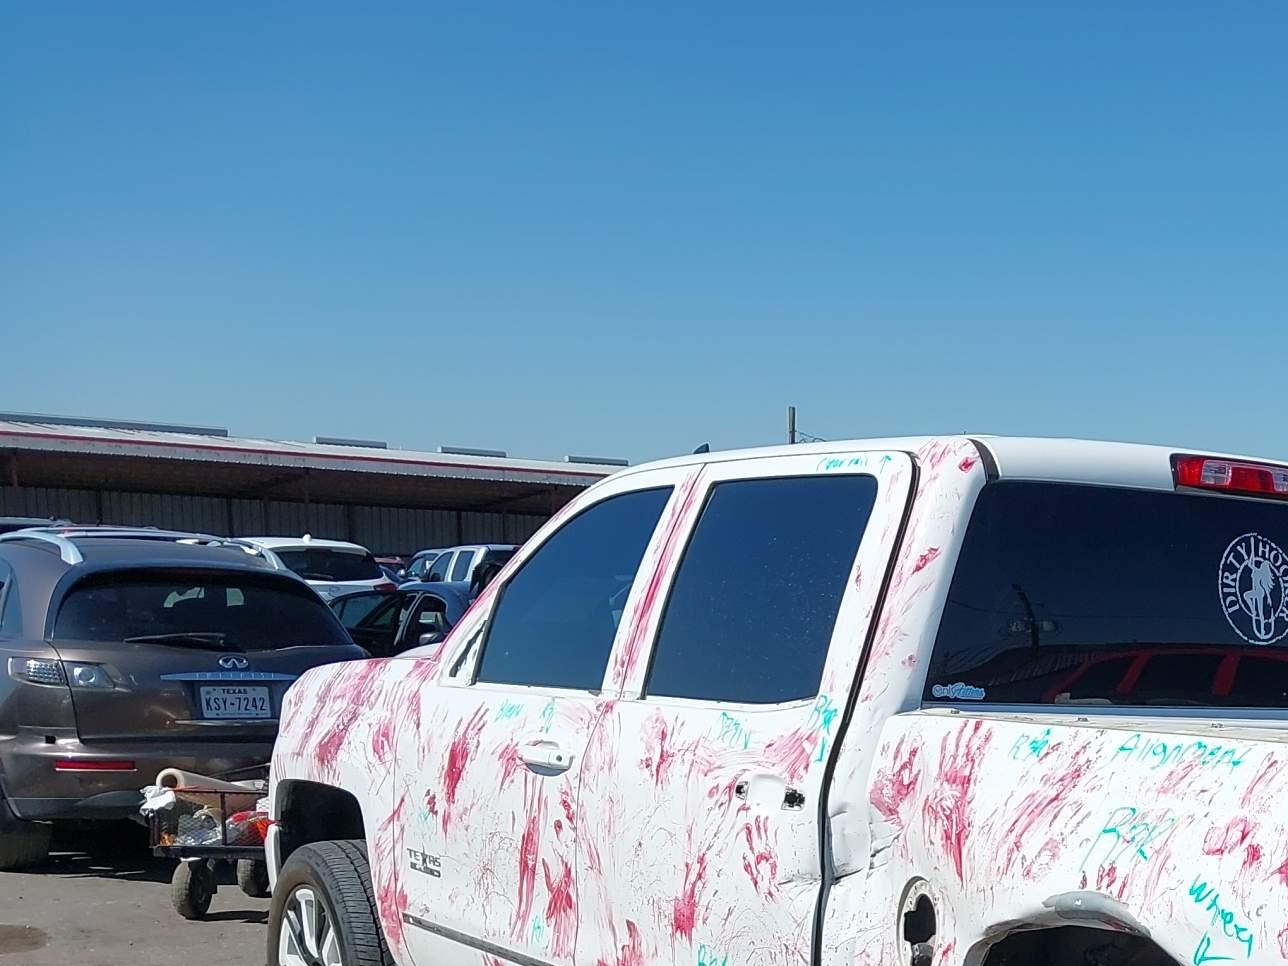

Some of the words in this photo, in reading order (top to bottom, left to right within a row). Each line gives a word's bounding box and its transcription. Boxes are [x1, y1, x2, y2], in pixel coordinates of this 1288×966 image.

[1223, 542, 1248, 613] DIRTY
[205, 697, 268, 711] KSY-7242
[406, 842, 441, 868] TEXAS
